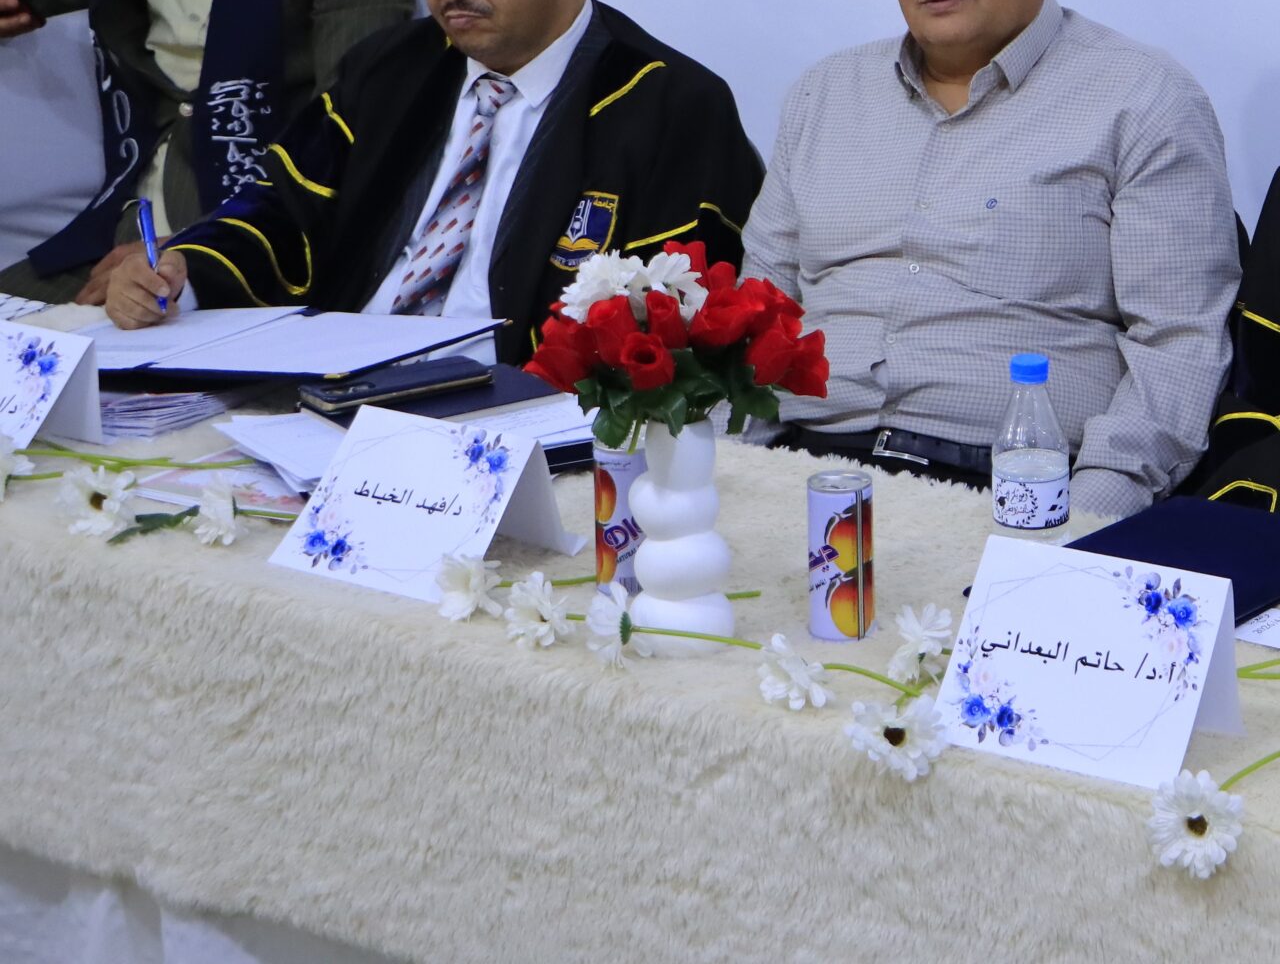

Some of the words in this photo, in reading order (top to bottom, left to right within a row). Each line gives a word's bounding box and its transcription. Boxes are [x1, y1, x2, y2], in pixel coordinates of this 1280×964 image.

[354, 480, 414, 505] الخياط
[981, 631, 1069, 665] البعداني
[1074, 650, 1125, 675] حاتم
